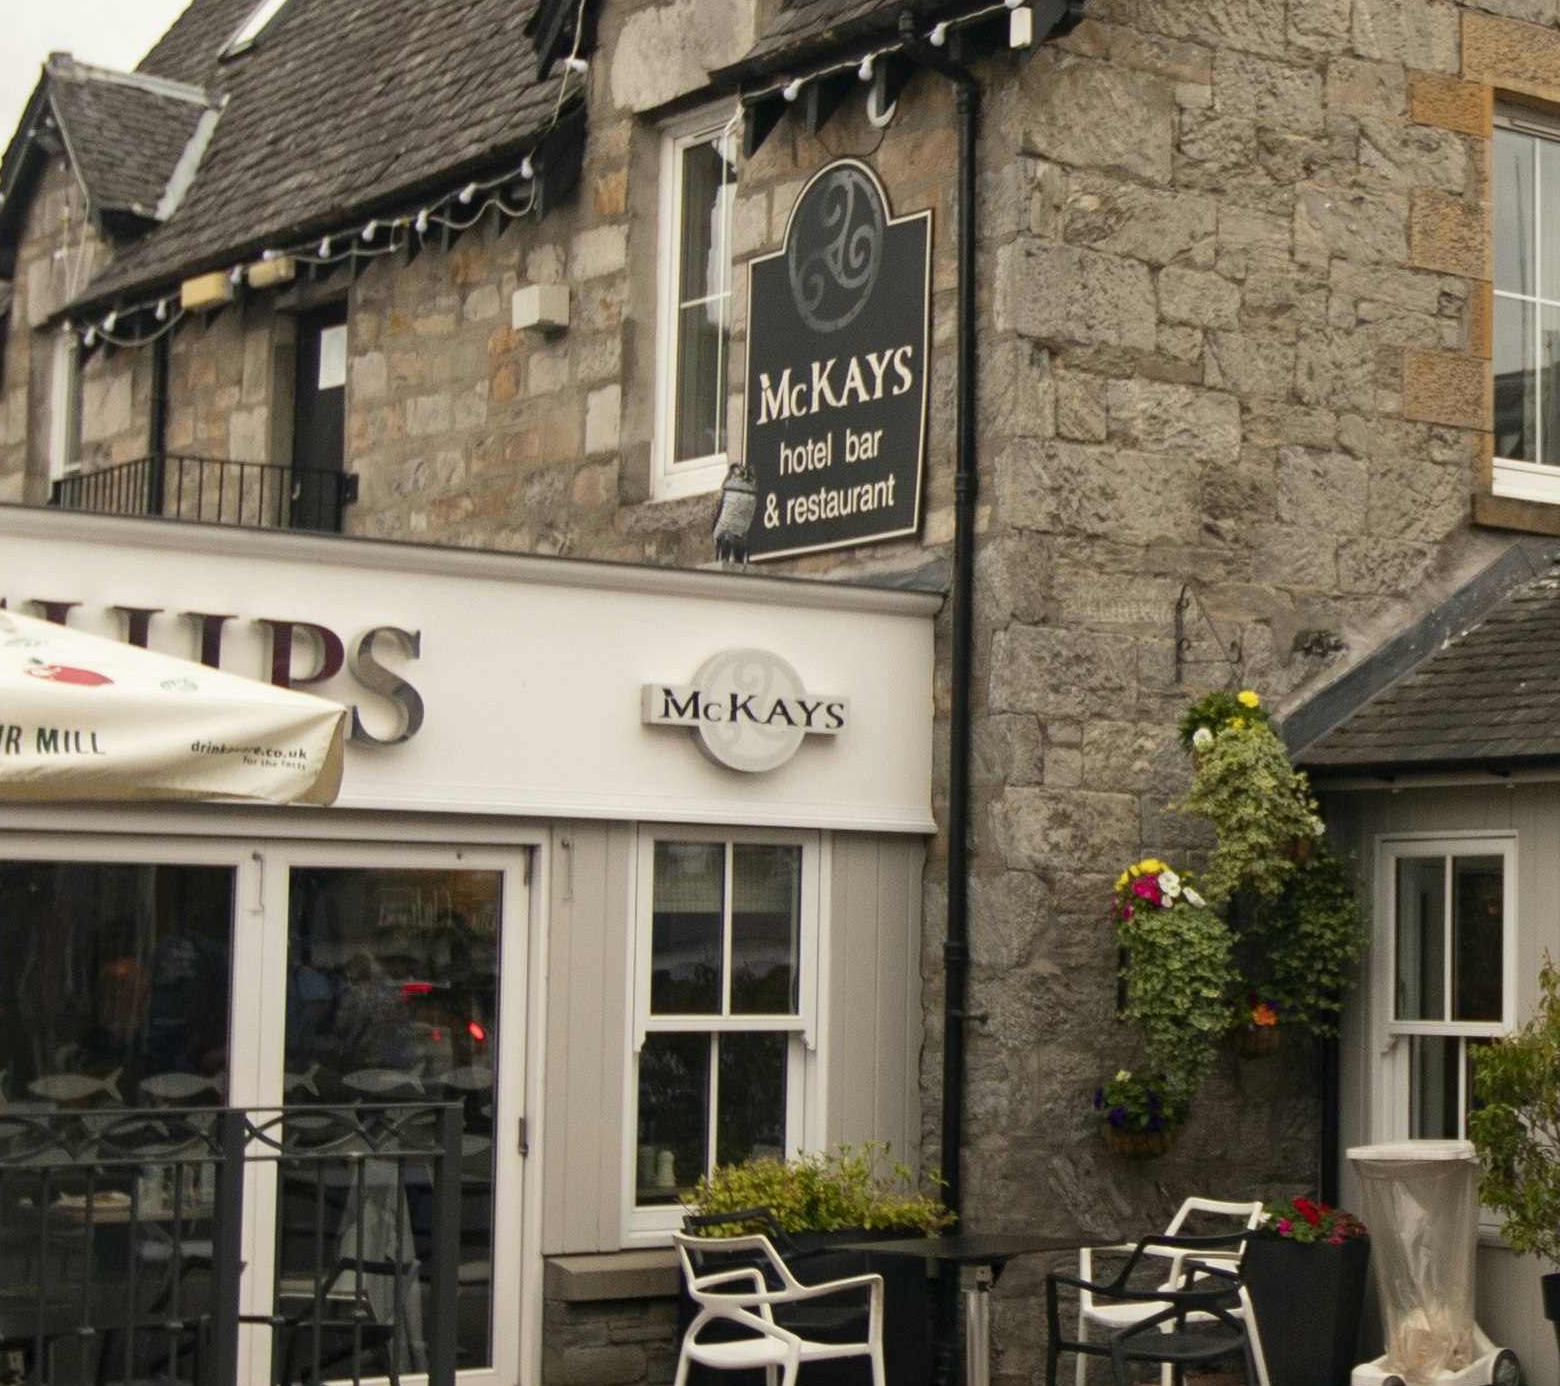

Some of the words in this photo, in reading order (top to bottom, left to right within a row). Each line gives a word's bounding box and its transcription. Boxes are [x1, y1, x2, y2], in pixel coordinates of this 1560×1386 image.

[756, 345, 915, 426] McKAYS
[779, 432, 833, 476] hotel
[844, 427, 884, 464] bar
[763, 492, 780, 530] &
[786, 474, 897, 526] restaurant
[659, 687, 845, 729] McKAYS
[37, 727, 107, 756] MILL
[242, 755, 258, 766] for
[261, 758, 278, 768] the
